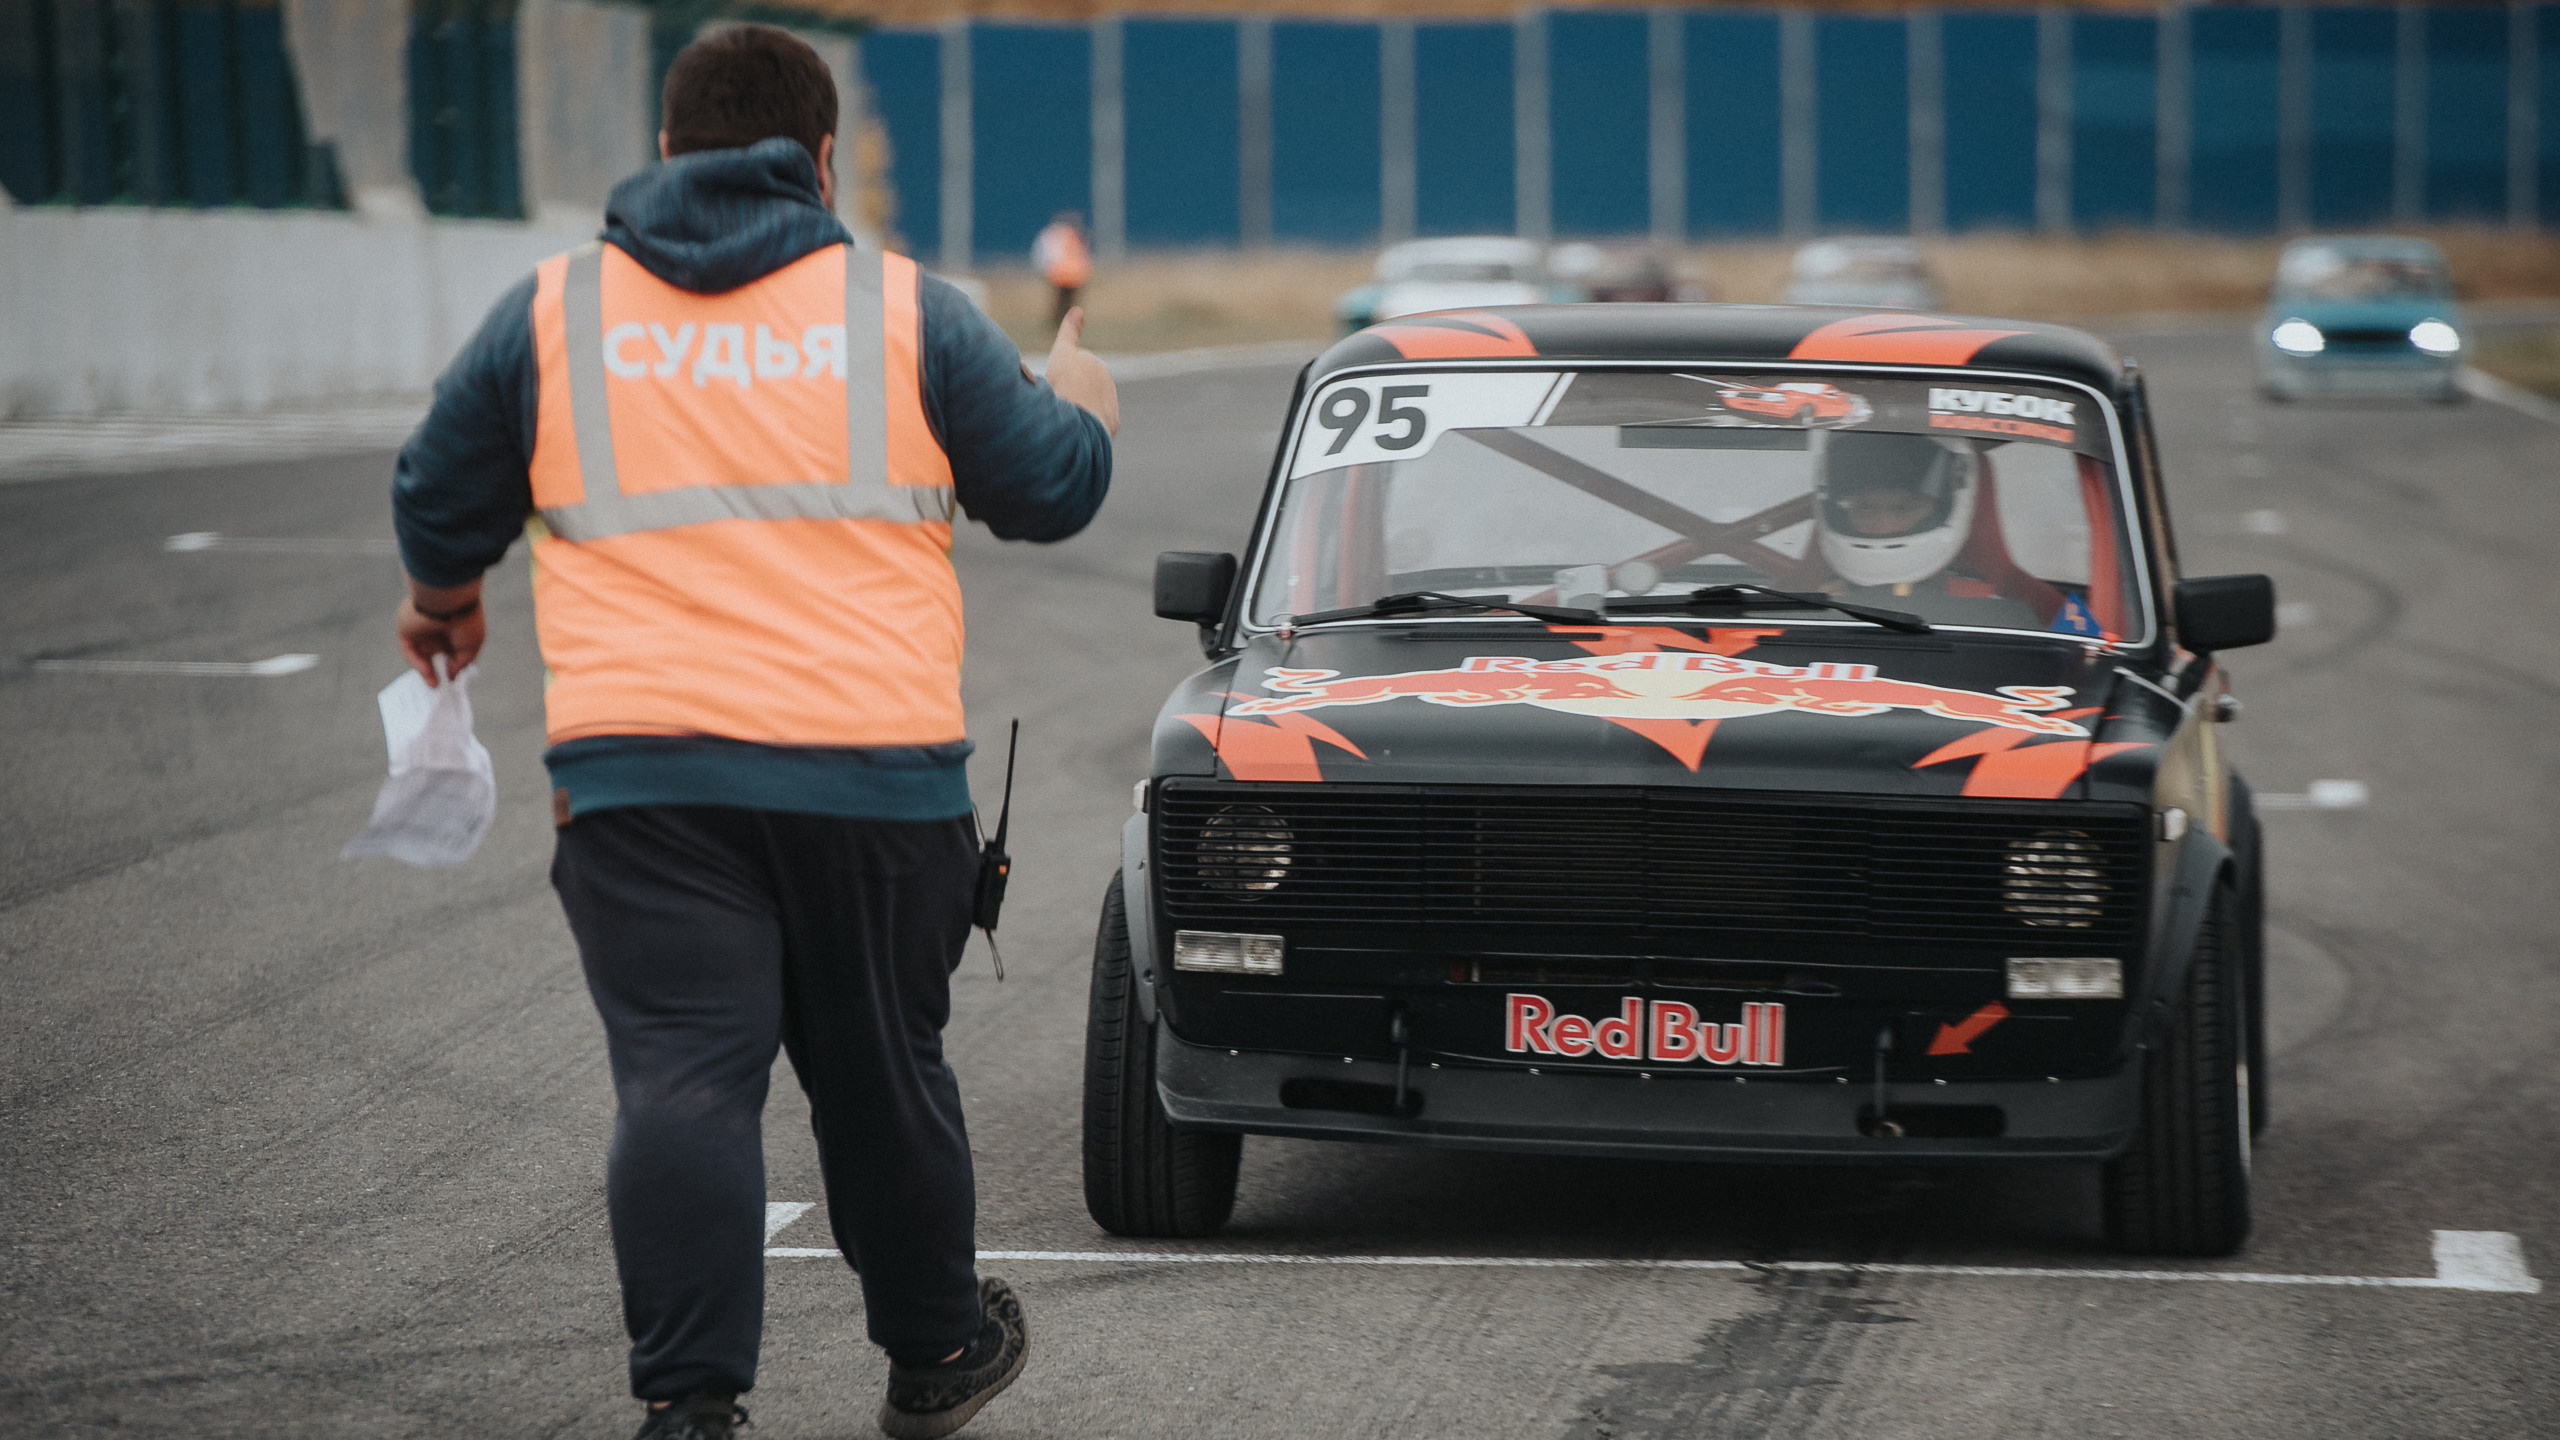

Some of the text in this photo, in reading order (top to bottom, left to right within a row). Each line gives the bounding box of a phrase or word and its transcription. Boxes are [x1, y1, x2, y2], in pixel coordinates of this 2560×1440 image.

[602, 321, 848, 388] СУДЬЯ
[1319, 385, 1430, 456] 95
[1928, 388, 2077, 425] КУБОК
[1463, 654, 1877, 681] Red Bull
[1506, 993, 1785, 1066] Red Bull
